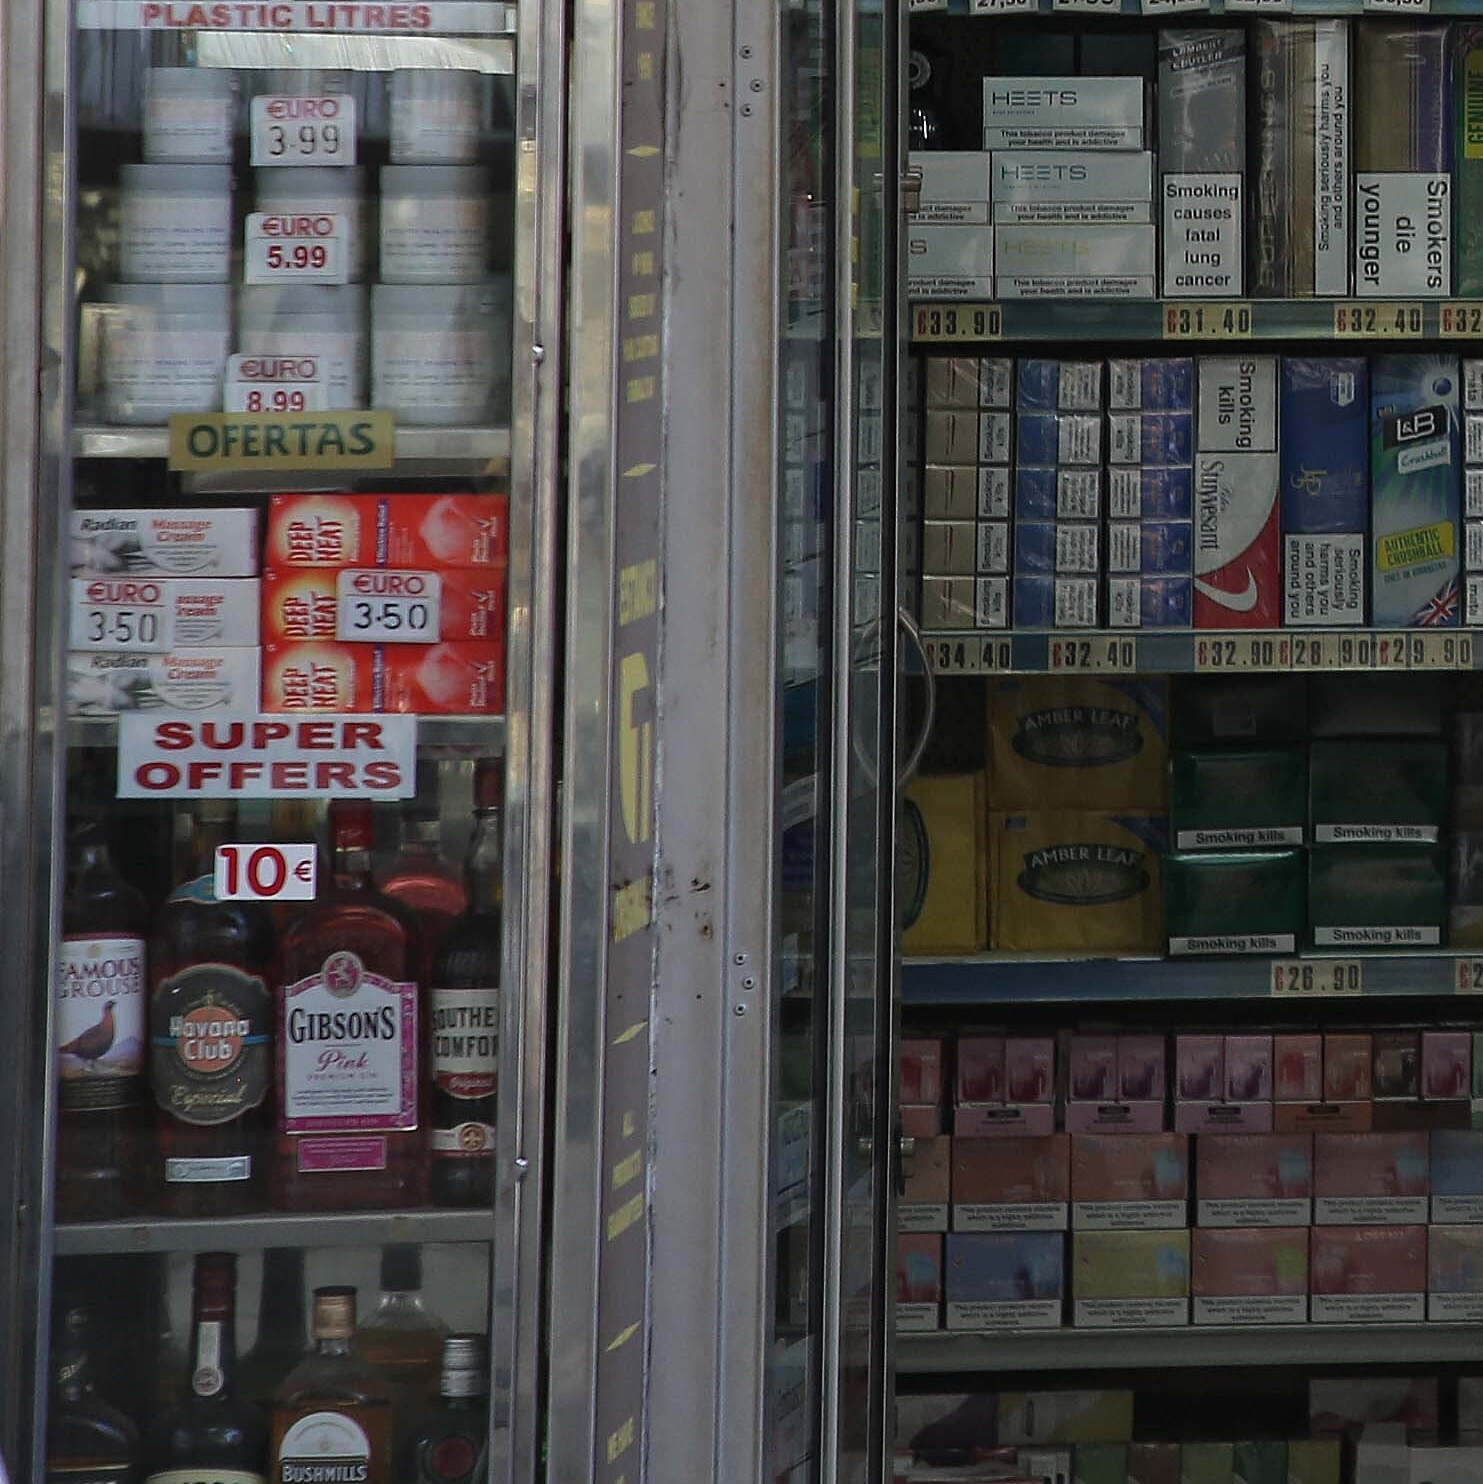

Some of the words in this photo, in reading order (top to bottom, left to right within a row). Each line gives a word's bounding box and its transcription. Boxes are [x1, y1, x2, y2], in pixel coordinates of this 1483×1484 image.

[141, 3, 293, 29] PLASTIC
[306, 3, 432, 29] LITRES
[992, 90, 1077, 107] HEETS
[1166, 183, 1239, 202] Smoking
[1173, 206, 1232, 220] causes
[1185, 227, 1221, 242] fatal
[1359, 183, 1382, 286] younger
[1426, 180, 1448, 289] Smokers
[266, 245, 326, 270] 5.99
[1184, 249, 1222, 268] lung
[1175, 273, 1231, 287] cancer
[247, 391, 305, 413] 8.99
[186, 422, 377, 459] OFERTAS
[153, 721, 387, 751] SUPER
[134, 761, 403, 791] OFFERS
[1333, 928, 1394, 944] Smoking
[1396, 927, 1423, 942] kills
[288, 1005, 396, 1044] GIBSON'S
[183, 1038, 234, 1062] Club
